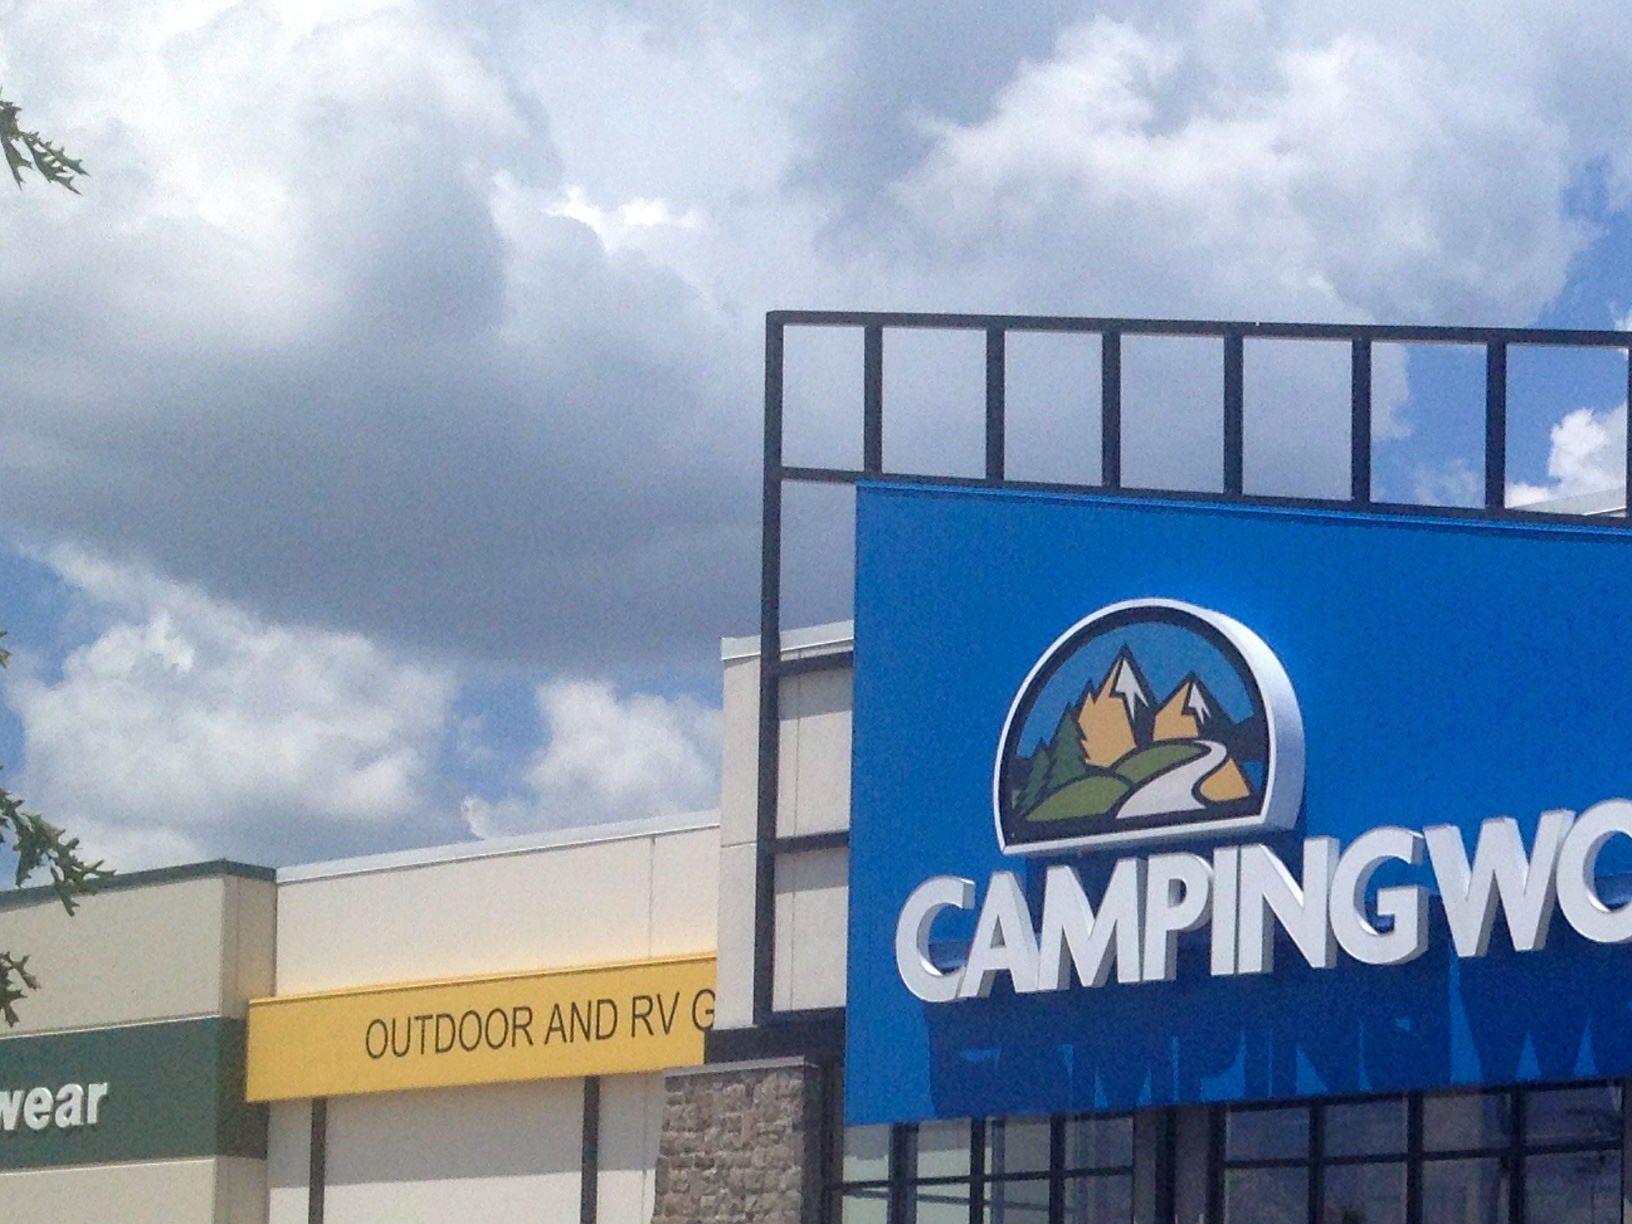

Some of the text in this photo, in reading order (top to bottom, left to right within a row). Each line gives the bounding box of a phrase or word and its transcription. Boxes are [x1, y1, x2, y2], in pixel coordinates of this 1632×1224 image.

[365, 1005, 534, 1059] OUTDOOR
[544, 998, 618, 1045] AND
[631, 991, 681, 1038] RV
